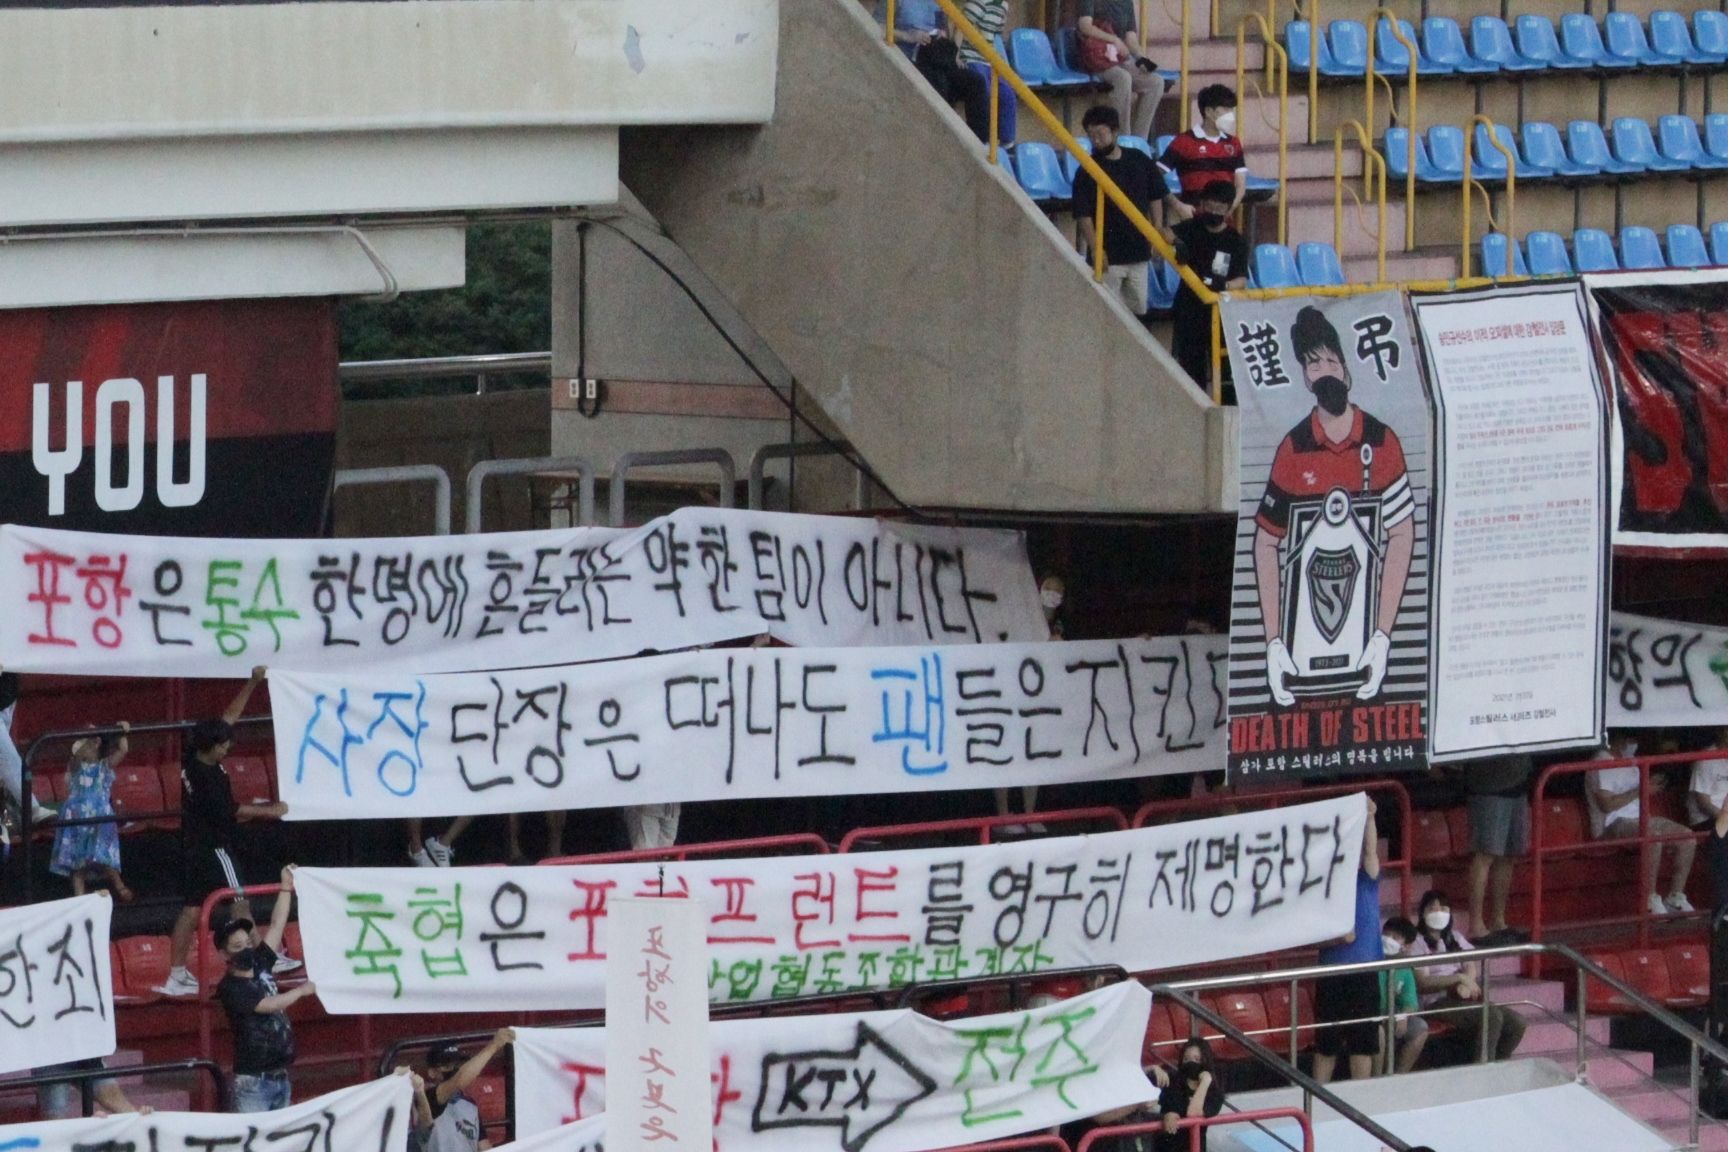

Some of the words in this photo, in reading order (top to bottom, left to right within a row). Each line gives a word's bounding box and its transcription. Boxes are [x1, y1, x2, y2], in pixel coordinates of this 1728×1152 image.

[31, 374, 207, 516] YOU
[24, 551, 192, 649] 포항은
[202, 558, 299, 656] 통수
[844, 539, 1010, 642] 아니다.
[295, 680, 429, 797] 사장
[451, 677, 641, 793] 단장은
[663, 655, 856, 785] 떠나도
[871, 652, 1063, 775] 팬들은
[1231, 711, 1309, 753] DEATH
[1321, 708, 1345, 746] OF
[1351, 702, 1424, 742] STEEL
[346, 880, 545, 998] 축협은
[1148, 816, 1346, 917] 제명한다
[778, 1066, 878, 1113] KTX
[953, 1006, 1099, 1127] 전주
